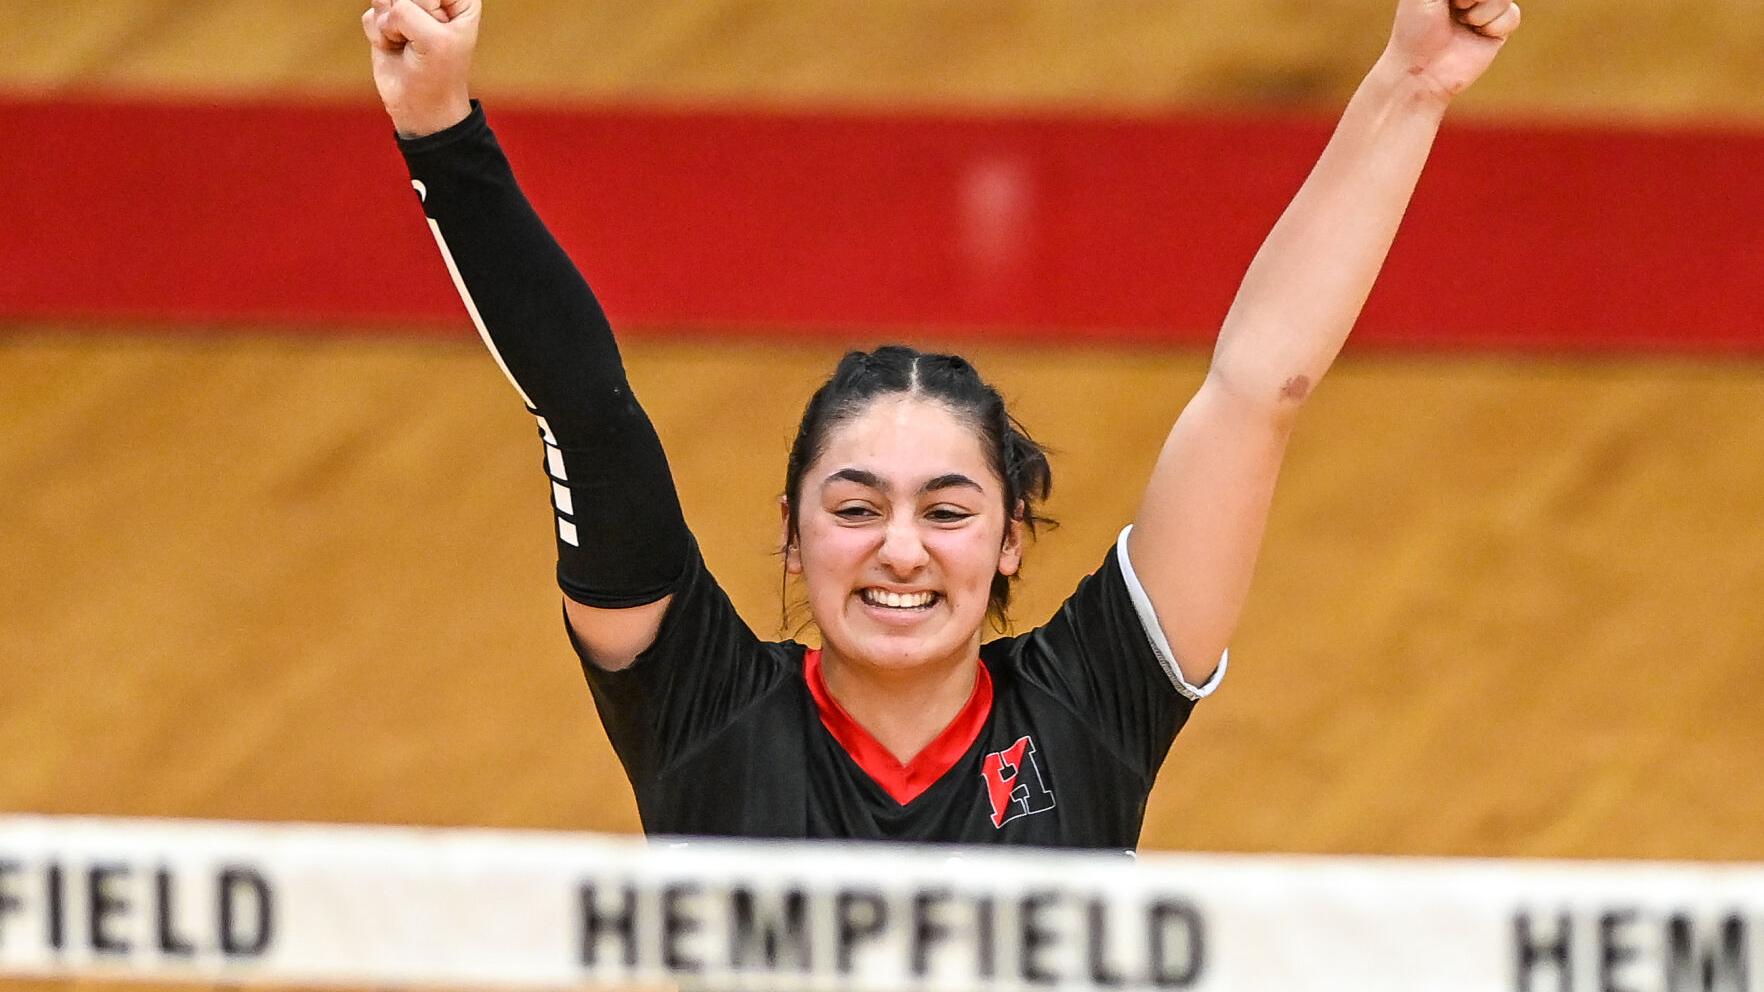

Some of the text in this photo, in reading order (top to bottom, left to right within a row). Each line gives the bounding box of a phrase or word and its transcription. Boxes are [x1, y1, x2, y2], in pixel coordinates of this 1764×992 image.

[982, 735, 1056, 829] H
[579, 882, 1206, 989] HEMPFIELD
[1513, 910, 1749, 992] HEM
